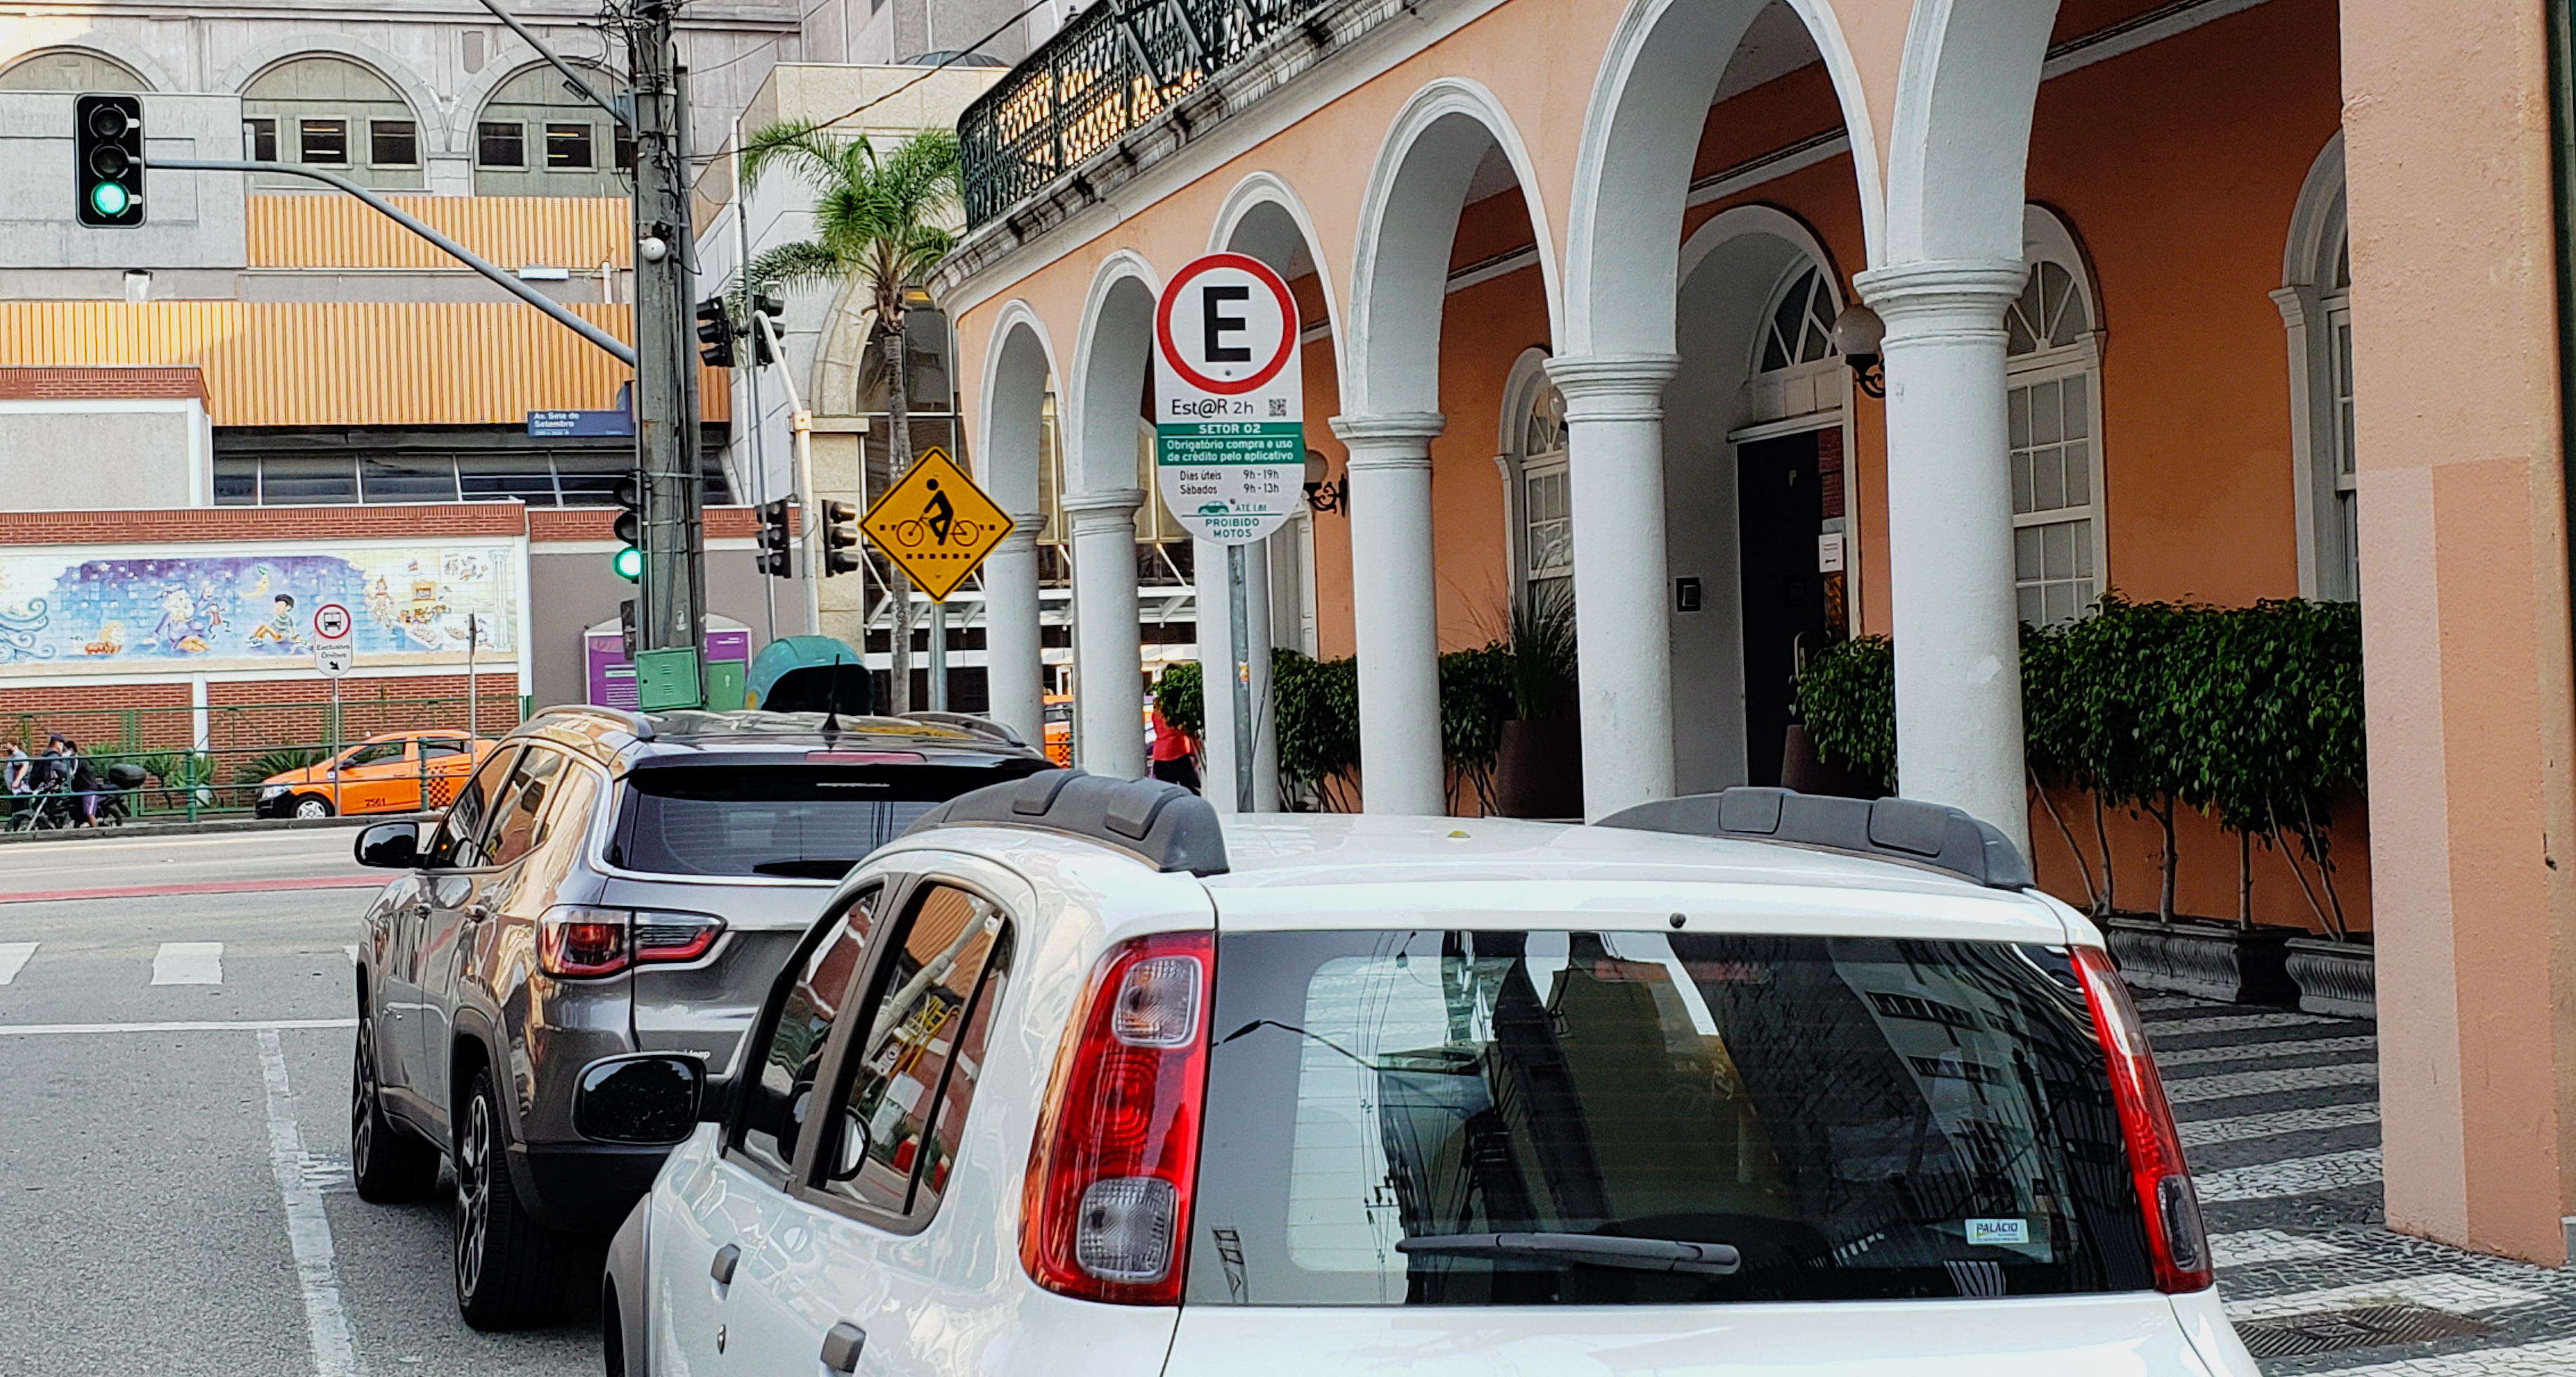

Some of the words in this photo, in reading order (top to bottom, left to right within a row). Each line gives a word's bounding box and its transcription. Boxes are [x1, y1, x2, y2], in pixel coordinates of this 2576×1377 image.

[1203, 286, 1251, 363] E
[1171, 398, 1228, 419] Est@R
[1232, 400, 1254, 415] 2h
[549, 412, 567, 420] Sete
[568, 412, 580, 420] de
[1199, 424, 1240, 434] SETOR
[1243, 423, 1261, 433] 02
[1166, 439, 1224, 452] Obrigatório
[1225, 440, 1265, 451] compra
[1266, 440, 1273, 448] e
[1275, 440, 1293, 448] uso
[1167, 452, 1180, 462] de
[1182, 450, 1218, 462] crédito
[1220, 451, 1242, 463] pelo
[1244, 450, 1294, 462] aplicativo
[1180, 471, 1199, 481] Dias
[1201, 469, 1222, 481] úteis
[1243, 469, 1255, 479] 9h
[1264, 469, 1280, 479] 19h
[1180, 483, 1218, 495] Sábados
[1243, 483, 1255, 493] 9h
[1264, 483, 1280, 493] 13h
[1205, 518, 1260, 527] PROIBIDO
[1214, 528, 1253, 538] MOTOS
